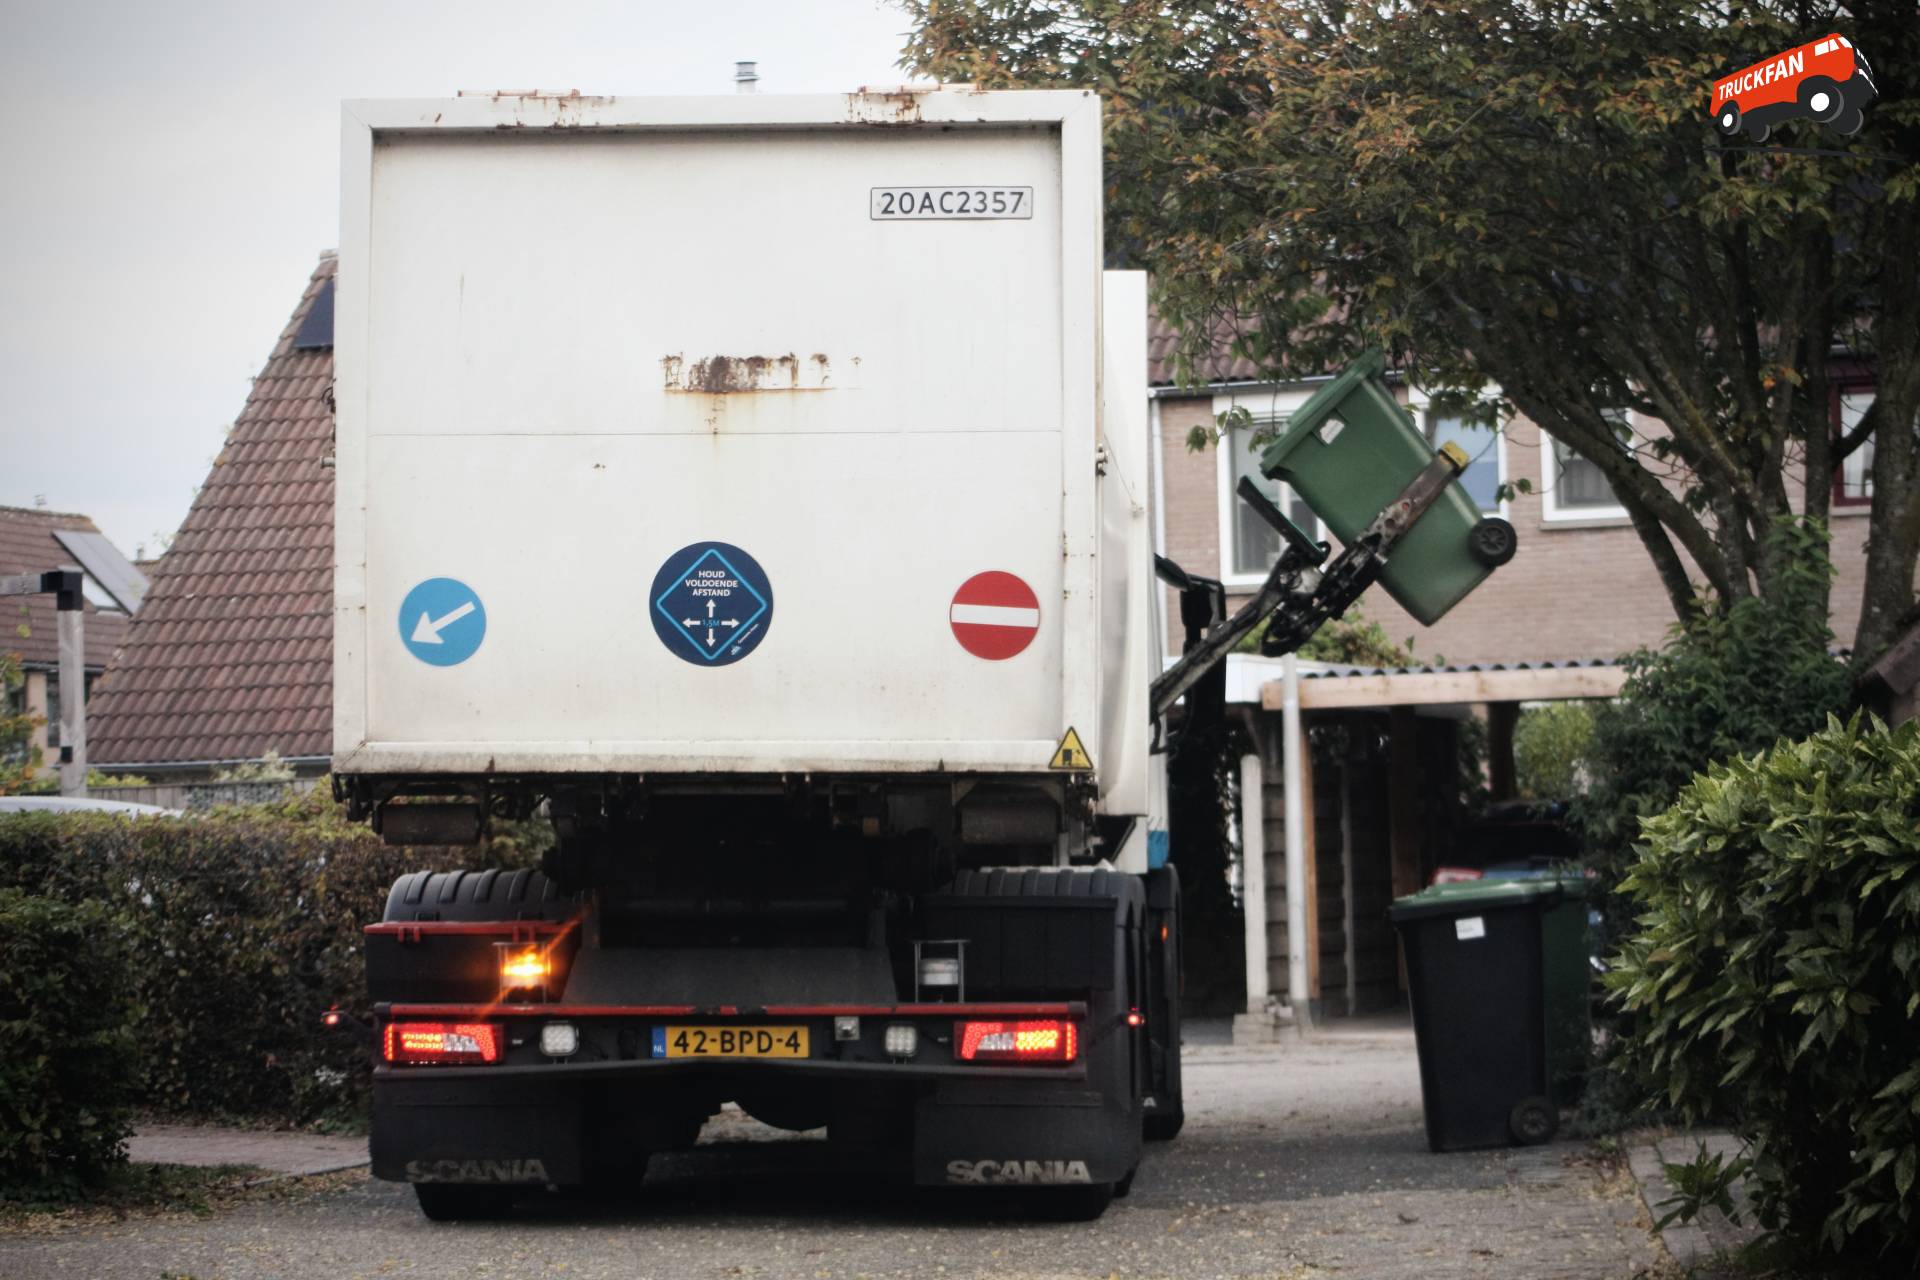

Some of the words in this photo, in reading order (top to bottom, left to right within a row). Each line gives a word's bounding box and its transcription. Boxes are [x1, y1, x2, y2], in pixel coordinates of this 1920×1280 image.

[881, 191, 1024, 215] 20AC2357
[685, 579, 738, 588] VOLDOENDE
[698, 570, 725, 578] HOUD
[692, 588, 731, 597] AFSTAND
[653, 1045, 664, 1053] NL
[674, 1030, 801, 1054] 42-BPD-4
[405, 1159, 549, 1183] SCANIA
[947, 1160, 1092, 1184] SCANIA
